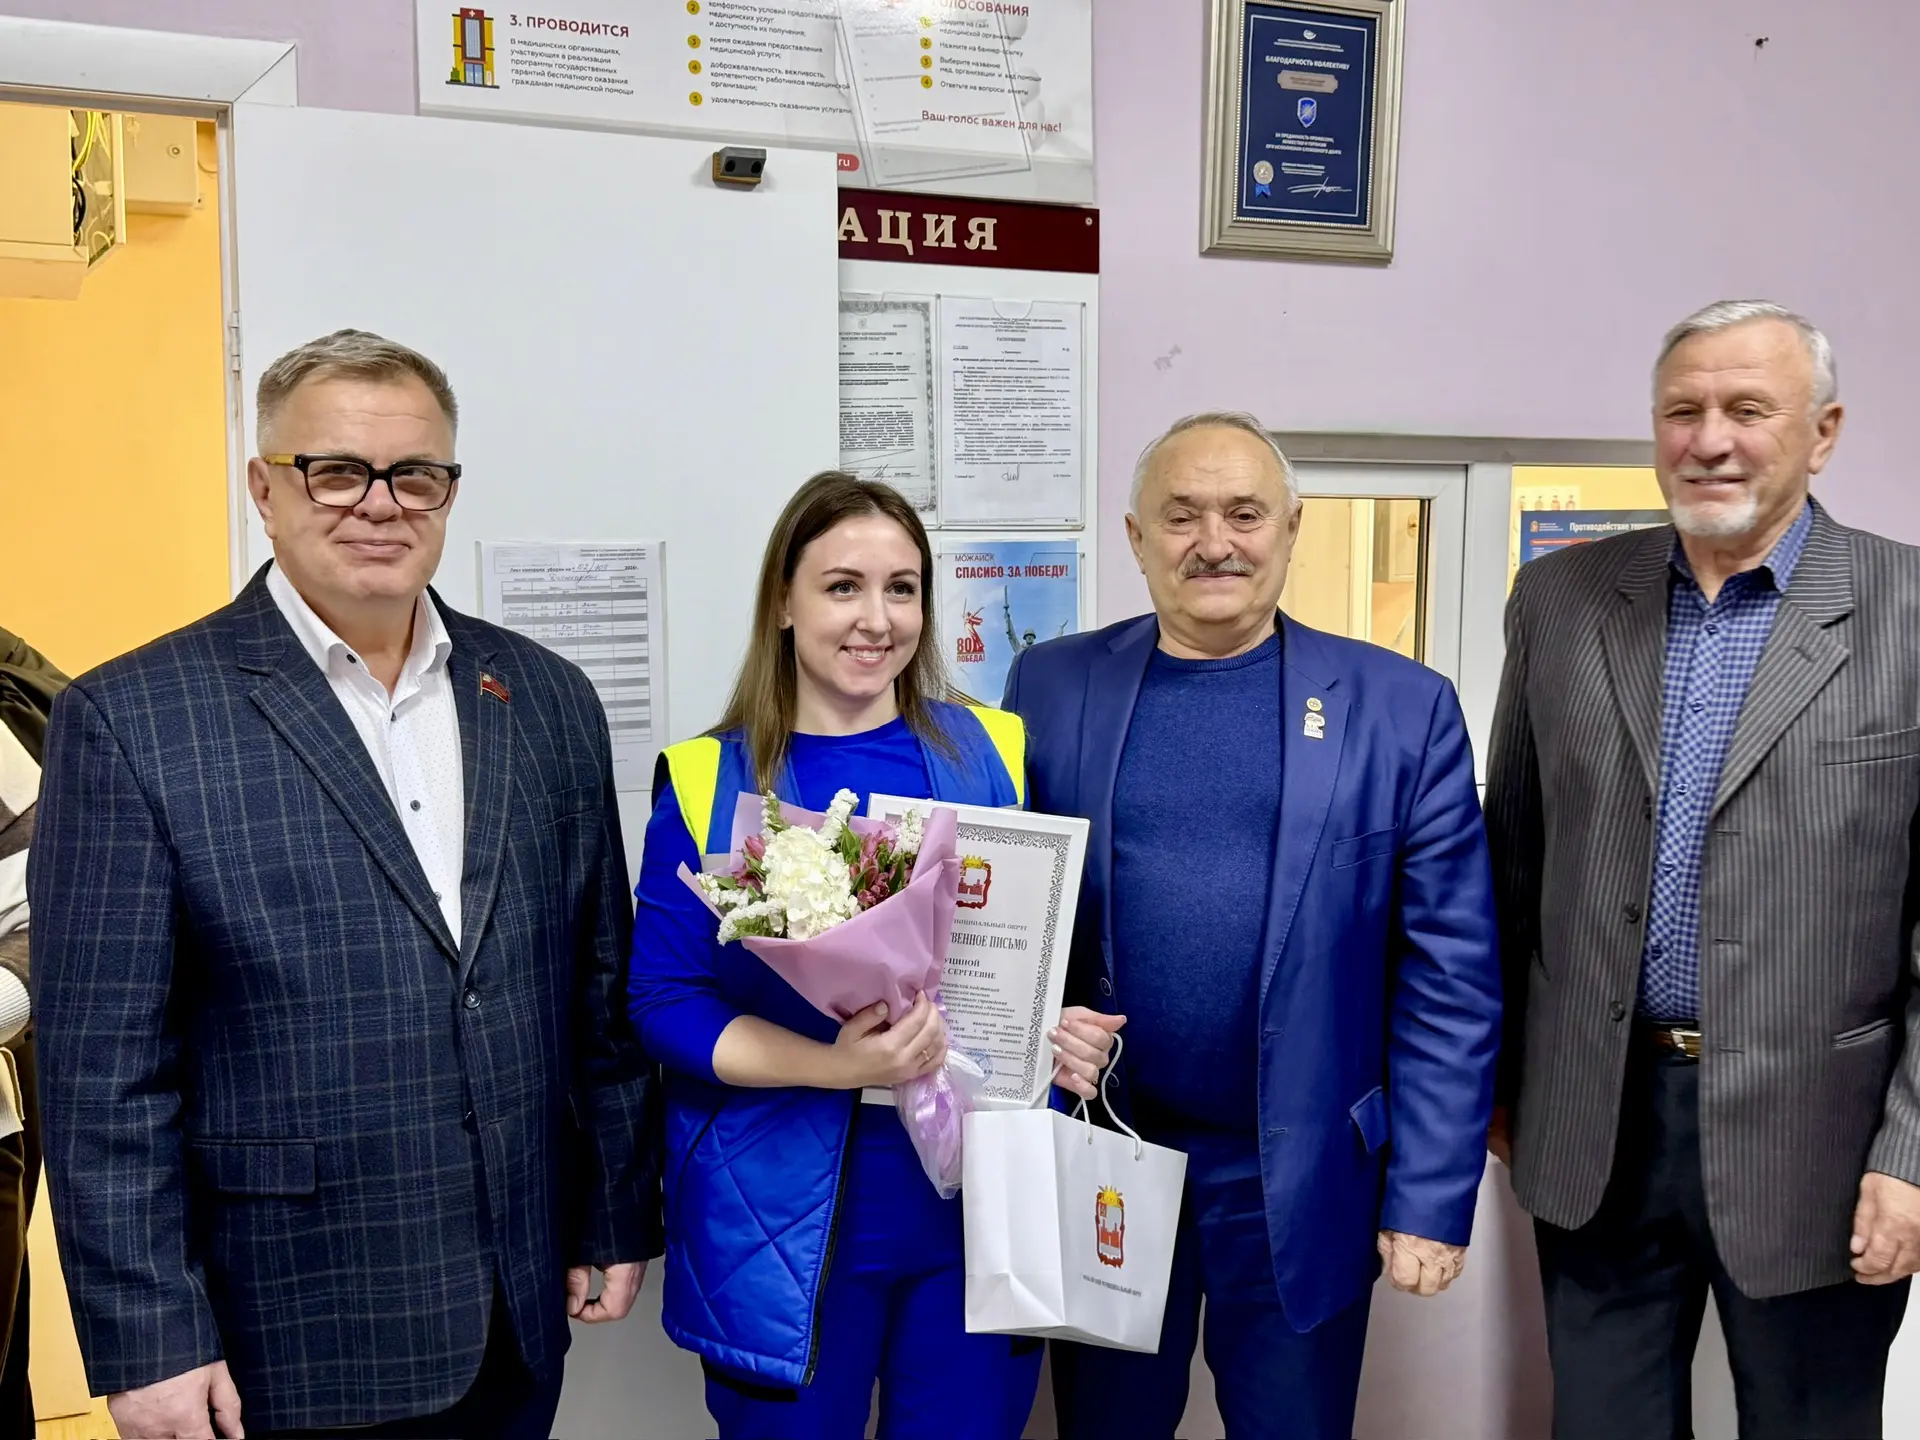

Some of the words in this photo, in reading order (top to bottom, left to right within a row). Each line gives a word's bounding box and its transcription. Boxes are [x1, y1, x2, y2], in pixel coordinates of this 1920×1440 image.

[708, 1, 757, 14] комфортность
[758, 5, 787, 17] условий
[709, 11, 755, 22] медицинских
[510, 14, 522, 27] 3.
[526, 16, 629, 38] ПРОВОДИТСЯ
[715, 21, 758, 33] доступность
[517, 39, 567, 50] медицинских
[568, 44, 621, 56] организациях,
[709, 37, 732, 45] время
[732, 39, 767, 49] ожидания
[767, 42, 824, 54] предоставления
[709, 46, 756, 56] медицинской
[940, 41, 968, 51] Нажмите
[510, 48, 560, 60] участвующих
[567, 54, 612, 65] реализации
[940, 55, 971, 67] Выберите
[971, 61, 1001, 70] название
[1265, 55, 1314, 67] БЛАГОДАРНОСТЬ
[1314, 60, 1351, 71] КОЛЛЕКТИВУ
[510, 58, 554, 69] программы
[554, 61, 618, 75] государственных
[710, 61, 784, 76] доброжелательность,
[784, 69, 827, 80] вежливость,
[955, 68, 996, 79] организации
[511, 68, 546, 78] гарантий
[546, 70, 593, 82] бесплатного
[594, 75, 629, 86] оказания
[710, 71, 765, 84] компетентность
[765, 76, 806, 87] работников
[806, 80, 851, 91] медицинской
[512, 77, 554, 88] гражданам
[555, 81, 604, 93] медицинской
[604, 86, 635, 96] помощи
[711, 80, 758, 92] организации;
[940, 80, 968, 90] Ответьте
[978, 86, 1005, 95] вопросы
[711, 95, 778, 109] удовлетворенность
[779, 101, 821, 112] оказанными
[922, 110, 945, 122] Ваш
[948, 114, 979, 127] голос
[981, 118, 1016, 129] важен
[1018, 121, 1038, 132] для
[1040, 122, 1063, 133] нас!
[1569, 521, 1629, 533] Противодействие
[955, 566, 1004, 579] СПАСИБО
[1008, 565, 1021, 577] ЗА
[1024, 564, 1069, 578] ПОБЕДУ!
[957, 637, 972, 653] 80
[1007, 924, 1029, 932] ОКРУГ
[989, 936, 1028, 951] ПИСЬМО
[947, 968, 997, 980] СЕРГЕЕВНЕ
